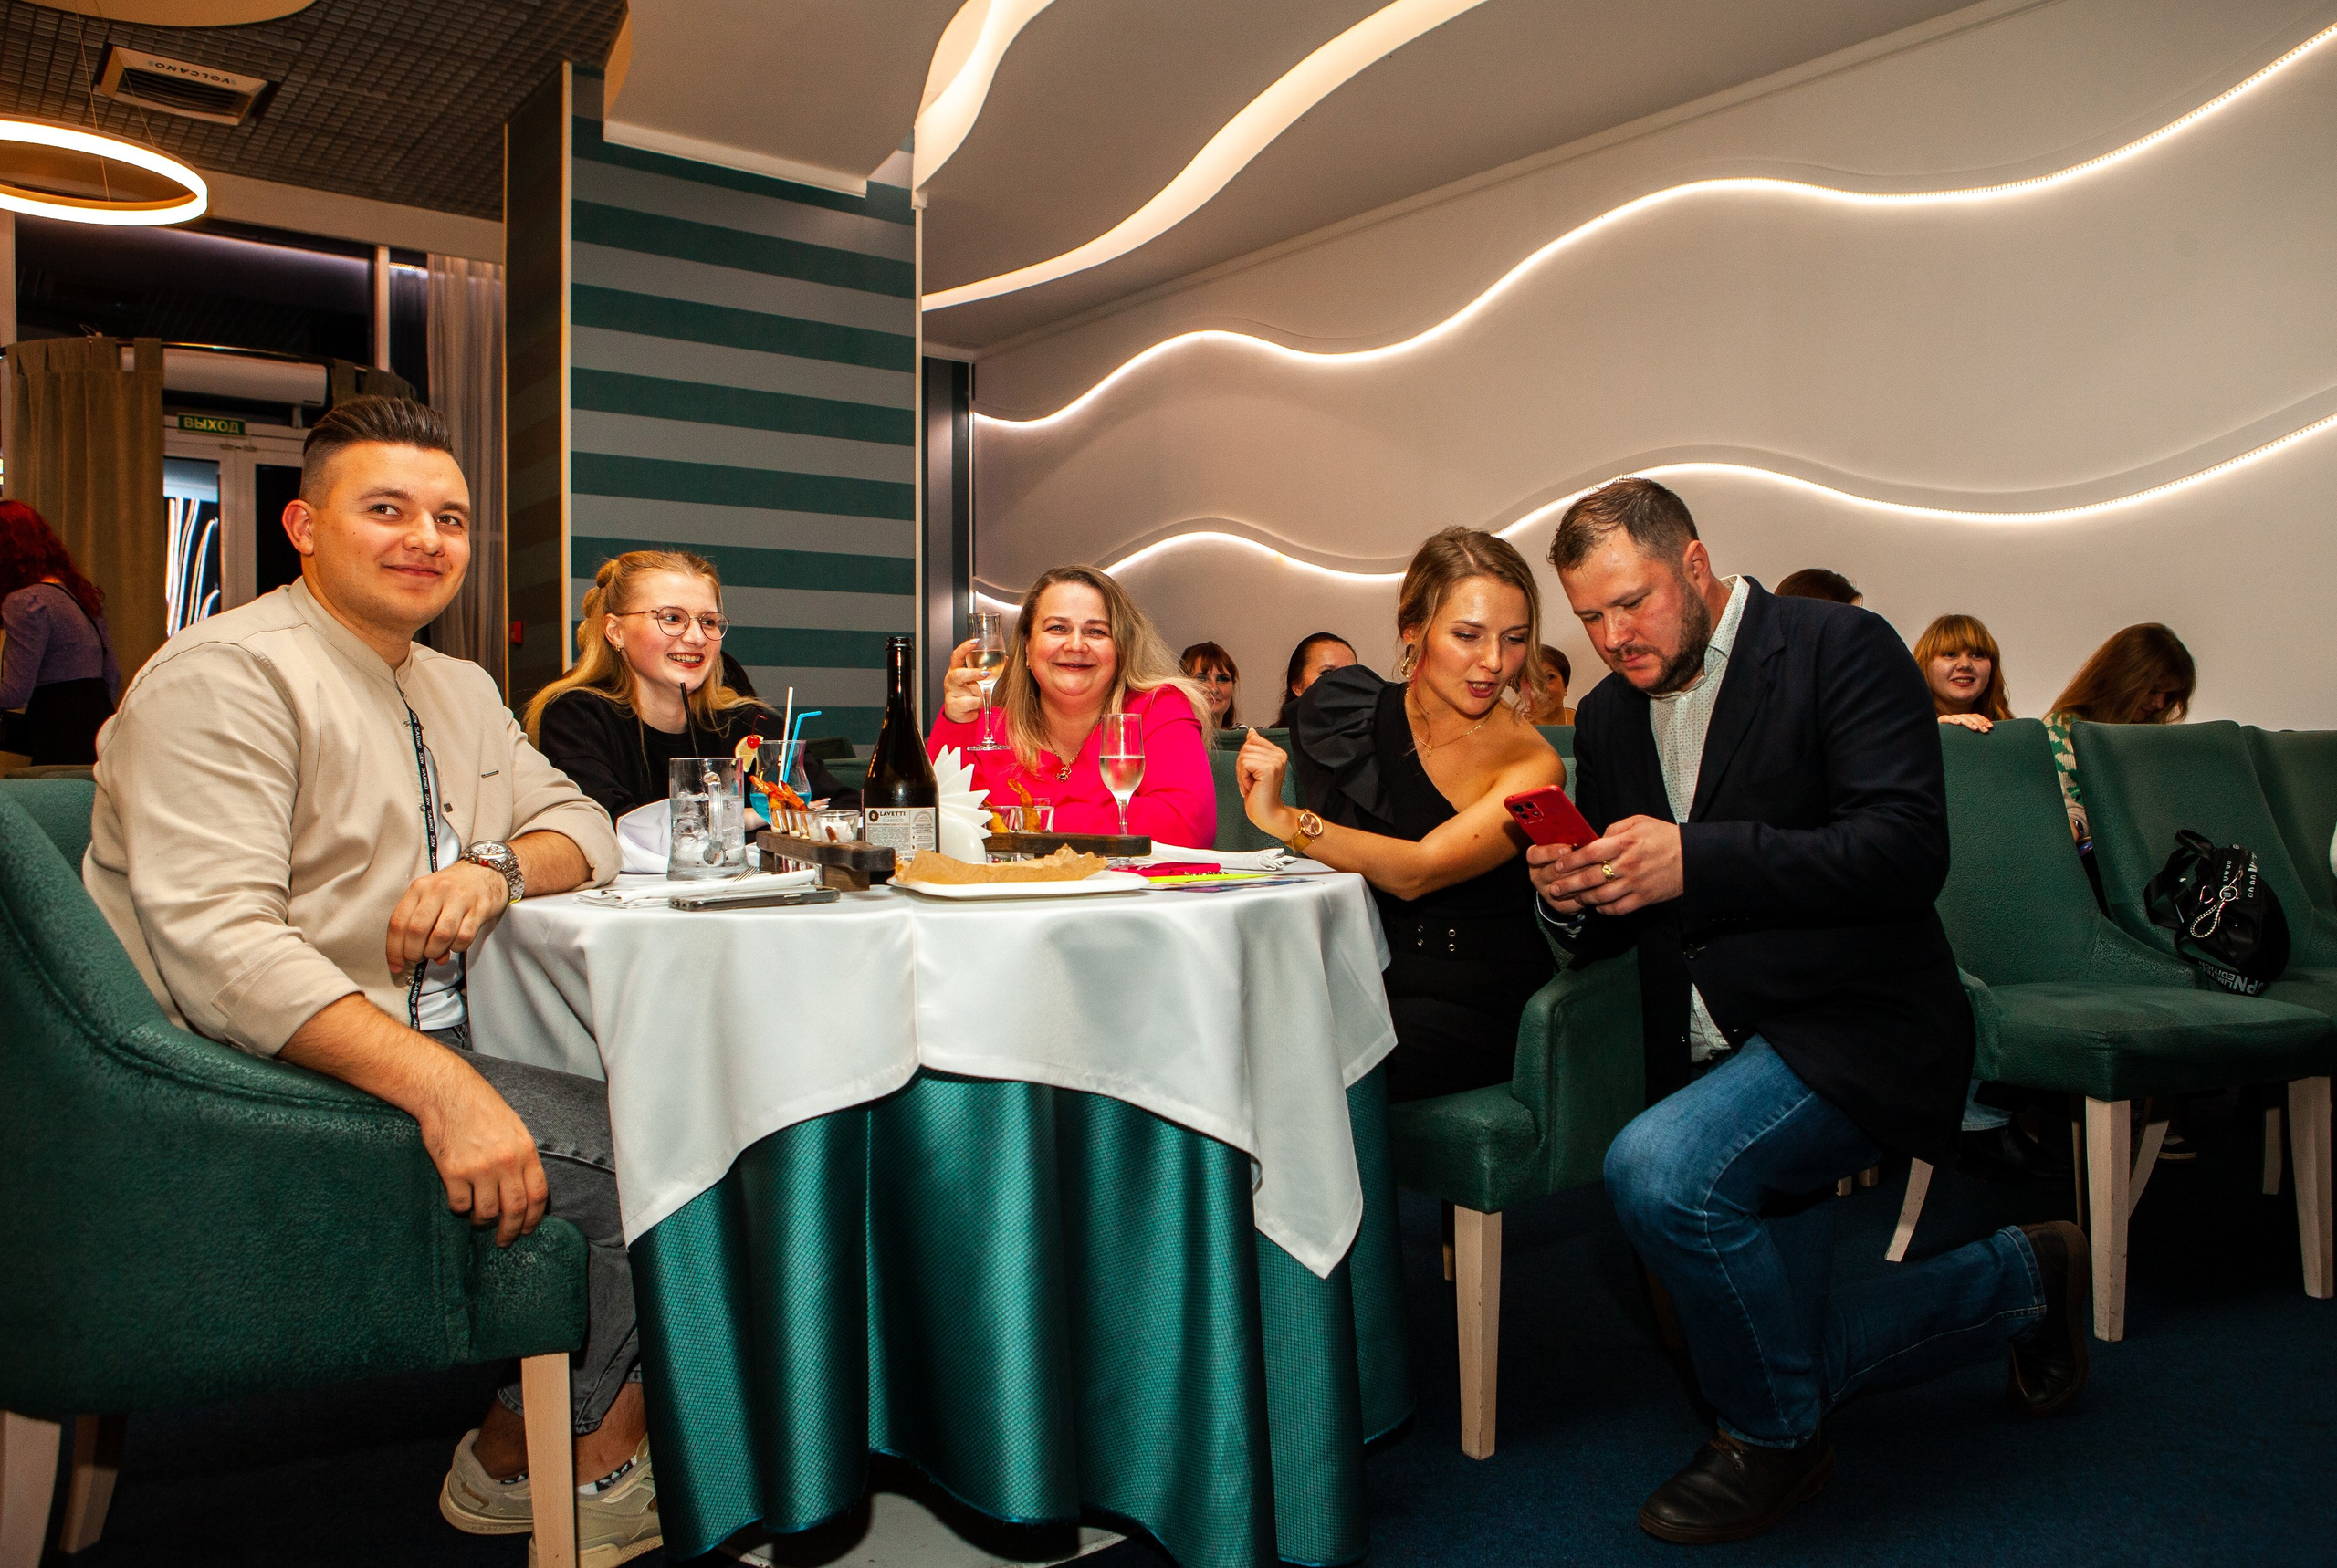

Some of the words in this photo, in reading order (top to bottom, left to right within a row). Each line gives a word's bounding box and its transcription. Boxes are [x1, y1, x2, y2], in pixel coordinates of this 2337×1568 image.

[155, 63, 229, 84] VOLCANO
[183, 417, 239, 434] ВЫХОД
[2198, 960, 2236, 981] EDITION
